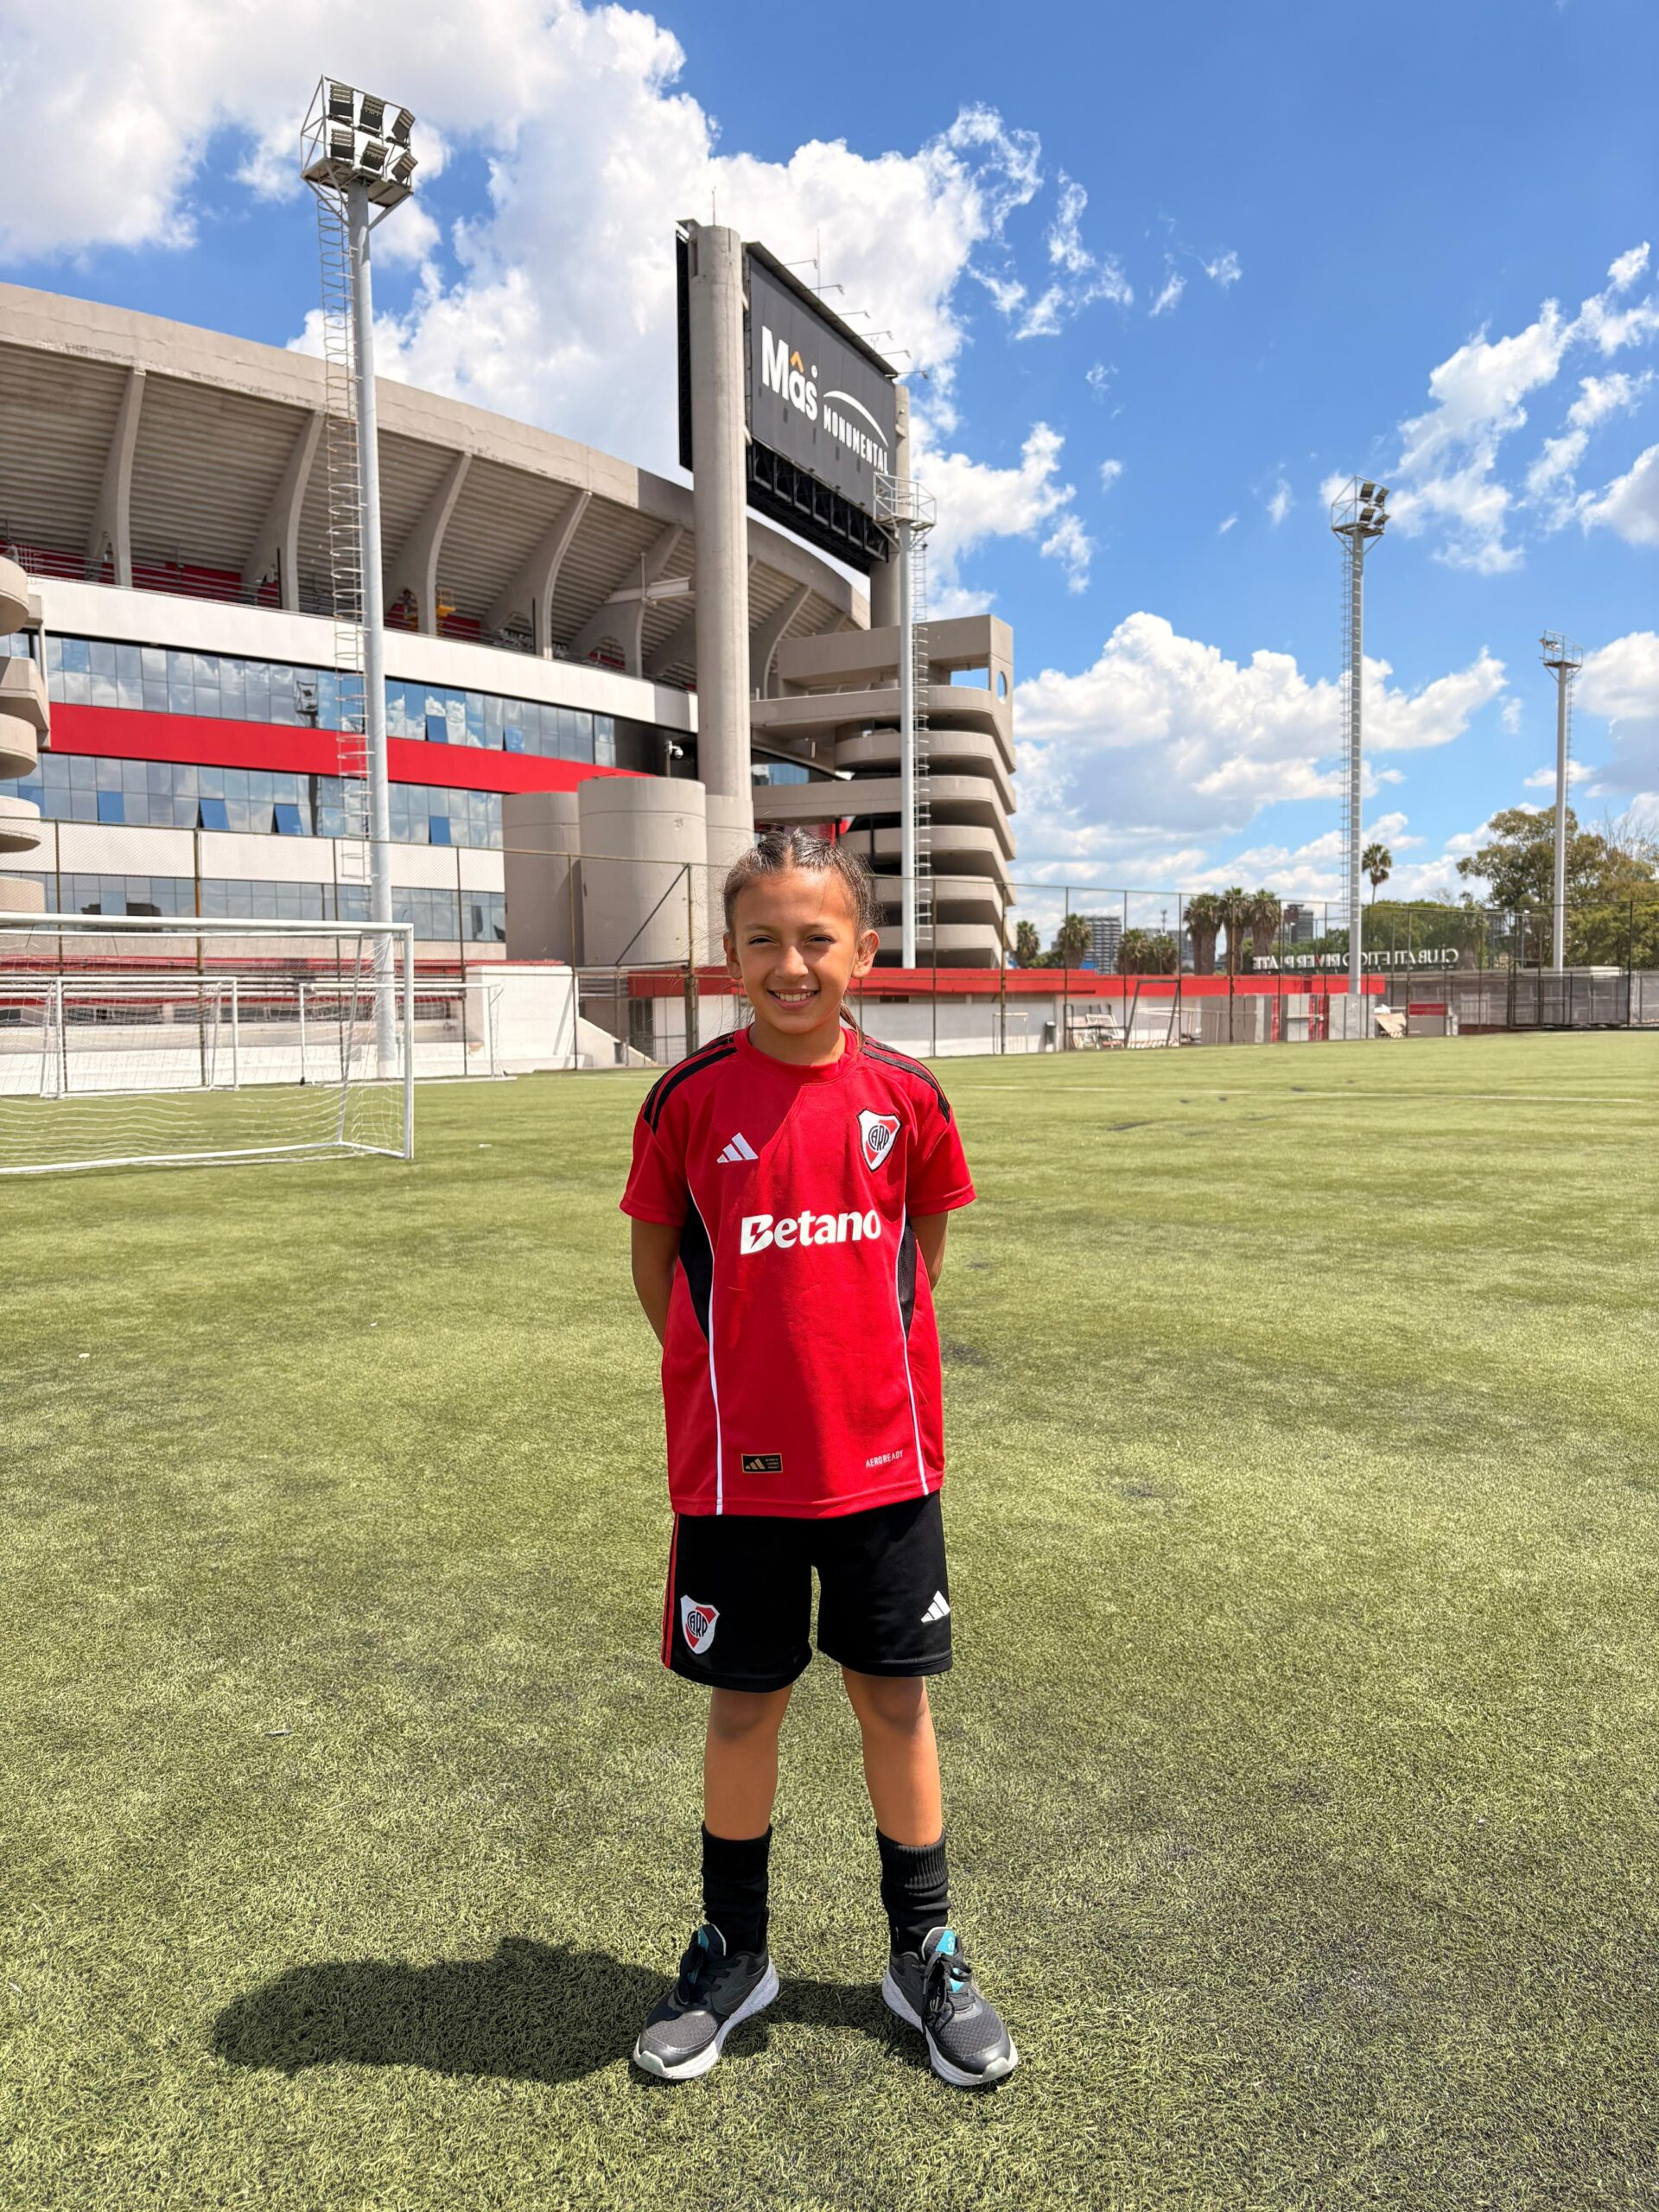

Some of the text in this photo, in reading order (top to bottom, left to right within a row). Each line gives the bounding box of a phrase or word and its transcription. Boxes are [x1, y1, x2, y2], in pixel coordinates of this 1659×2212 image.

[823, 404, 889, 474] MONUMENTAL
[741, 1210, 881, 1255] Betano
[865, 1449, 904, 1469] AEROREADY
